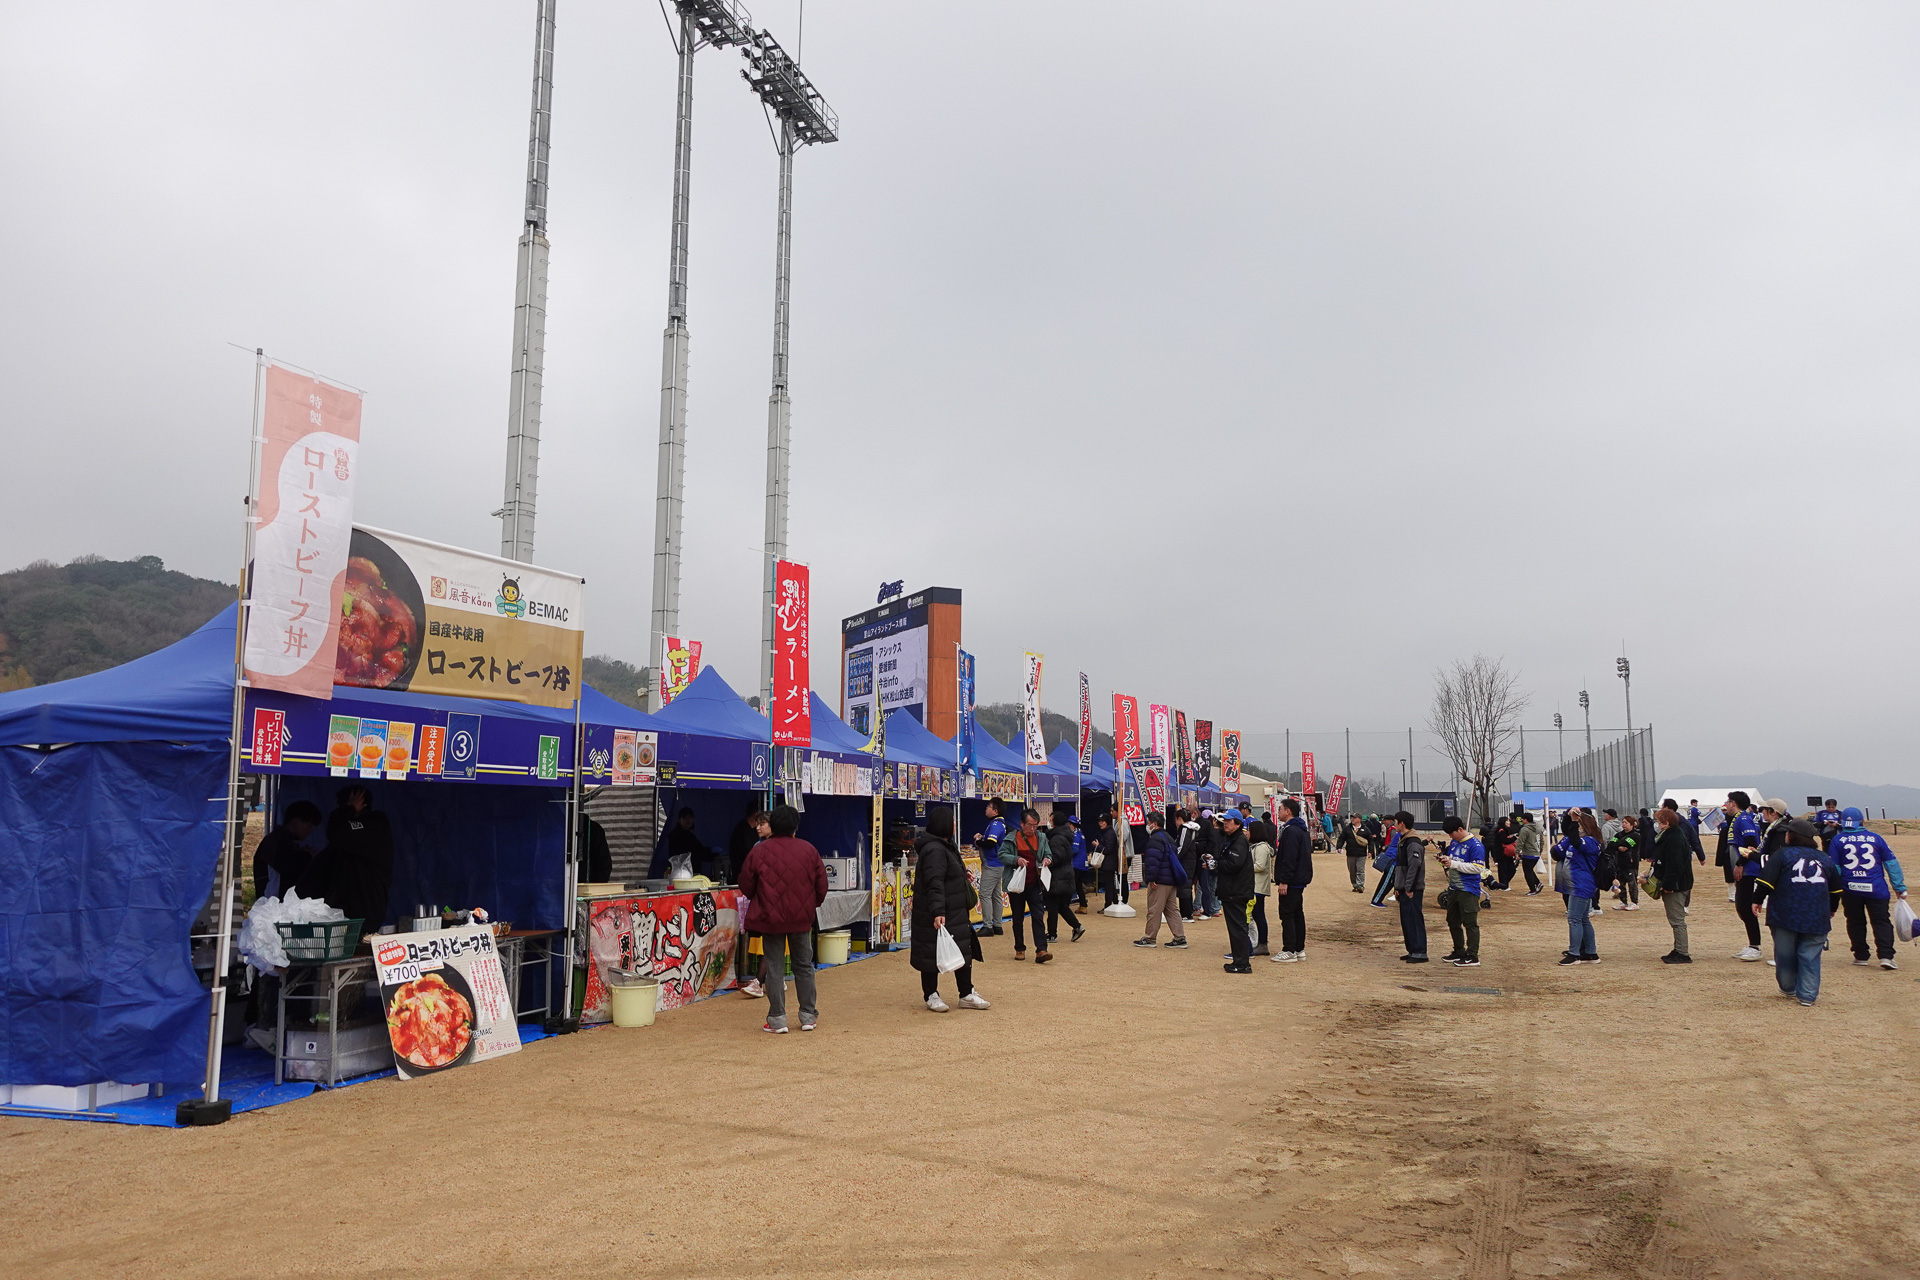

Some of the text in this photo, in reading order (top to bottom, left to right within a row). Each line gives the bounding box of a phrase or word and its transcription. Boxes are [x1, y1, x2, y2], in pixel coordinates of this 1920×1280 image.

[309, 394, 323, 426] 特製
[283, 447, 325, 658] ローストビーフ丼
[449, 587, 471, 604] 風音
[529, 601, 569, 622] BEMAC
[429, 620, 485, 643] 国産牛使用
[427, 649, 571, 692] ローストビーフ丼
[878, 676, 899, 689] 今治info
[272, 713, 282, 752] ロースト
[361, 736, 374, 745] ¥300
[1122, 700, 1137, 757] ラーメン
[255, 728, 265, 763] 受取場所
[263, 722, 275, 764] ビーフ丼
[425, 728, 438, 773] 注文受付
[456, 735, 467, 757] 3
[1224, 733, 1240, 779] 肉まん
[547, 738, 556, 778] ドリンク
[756, 758, 763, 774] 4
[874, 769, 880, 783] 5
[1839, 835, 1876, 844] 今治造船
[1843, 843, 1877, 870] 33
[1791, 857, 1826, 884] 12
[1852, 870, 1867, 878] SASA
[406, 933, 493, 961] ローストビーフ丼
[385, 965, 418, 983] ¥700
